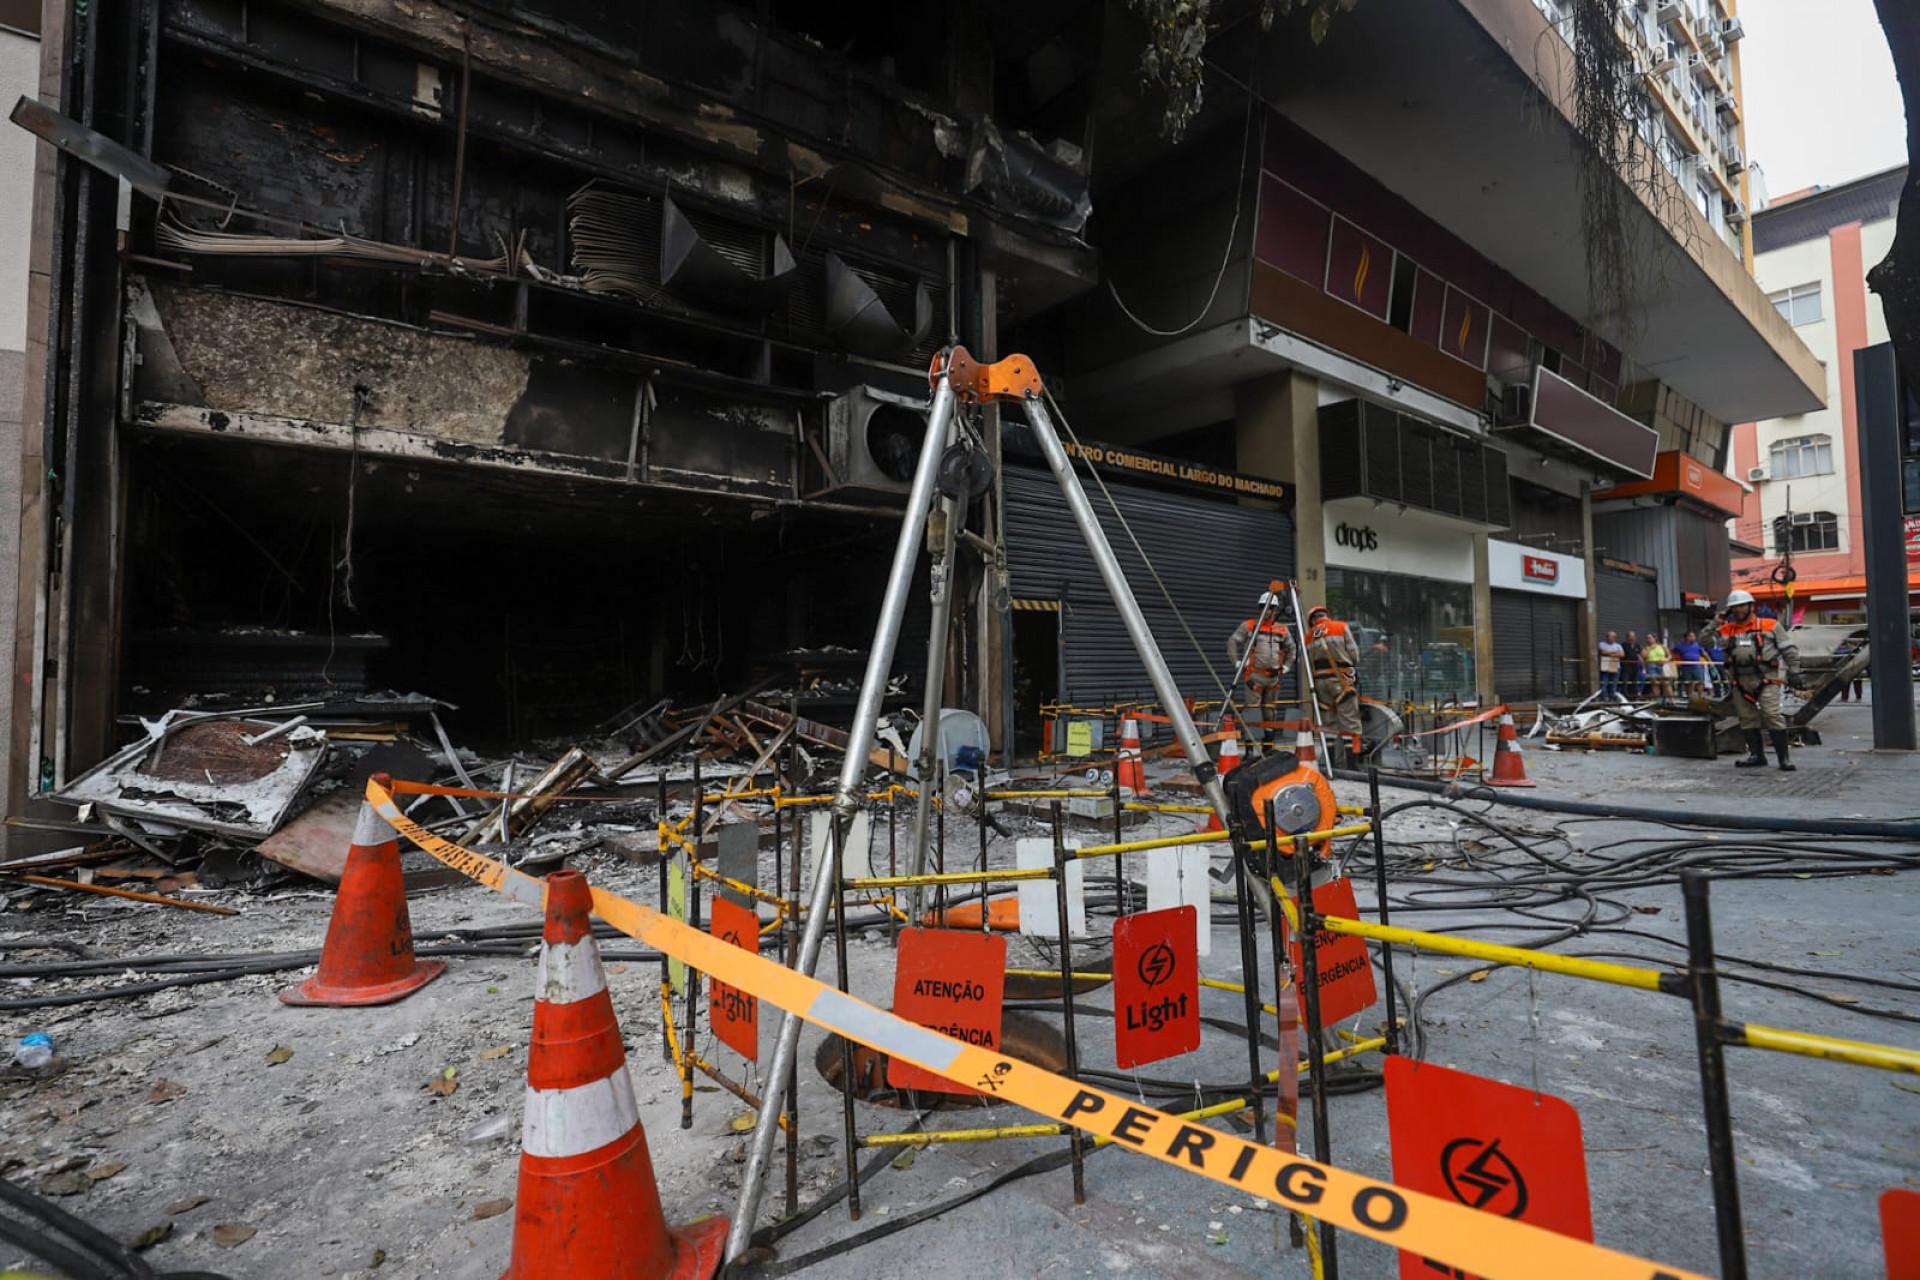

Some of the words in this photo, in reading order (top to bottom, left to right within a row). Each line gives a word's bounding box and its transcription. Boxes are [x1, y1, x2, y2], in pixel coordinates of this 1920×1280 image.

[1062, 442, 1103, 462] NTRO
[1105, 450, 1177, 477] COMERCIAL
[1179, 465, 1216, 484] LARGO
[1218, 474, 1233, 488] DO
[1235, 477, 1283, 498] MACHADO
[1335, 522, 1378, 552] drops
[913, 980, 985, 1003] ATENÇÃO
[1126, 992, 1187, 1032] Light
[1061, 1089, 1409, 1232] PERIGO
